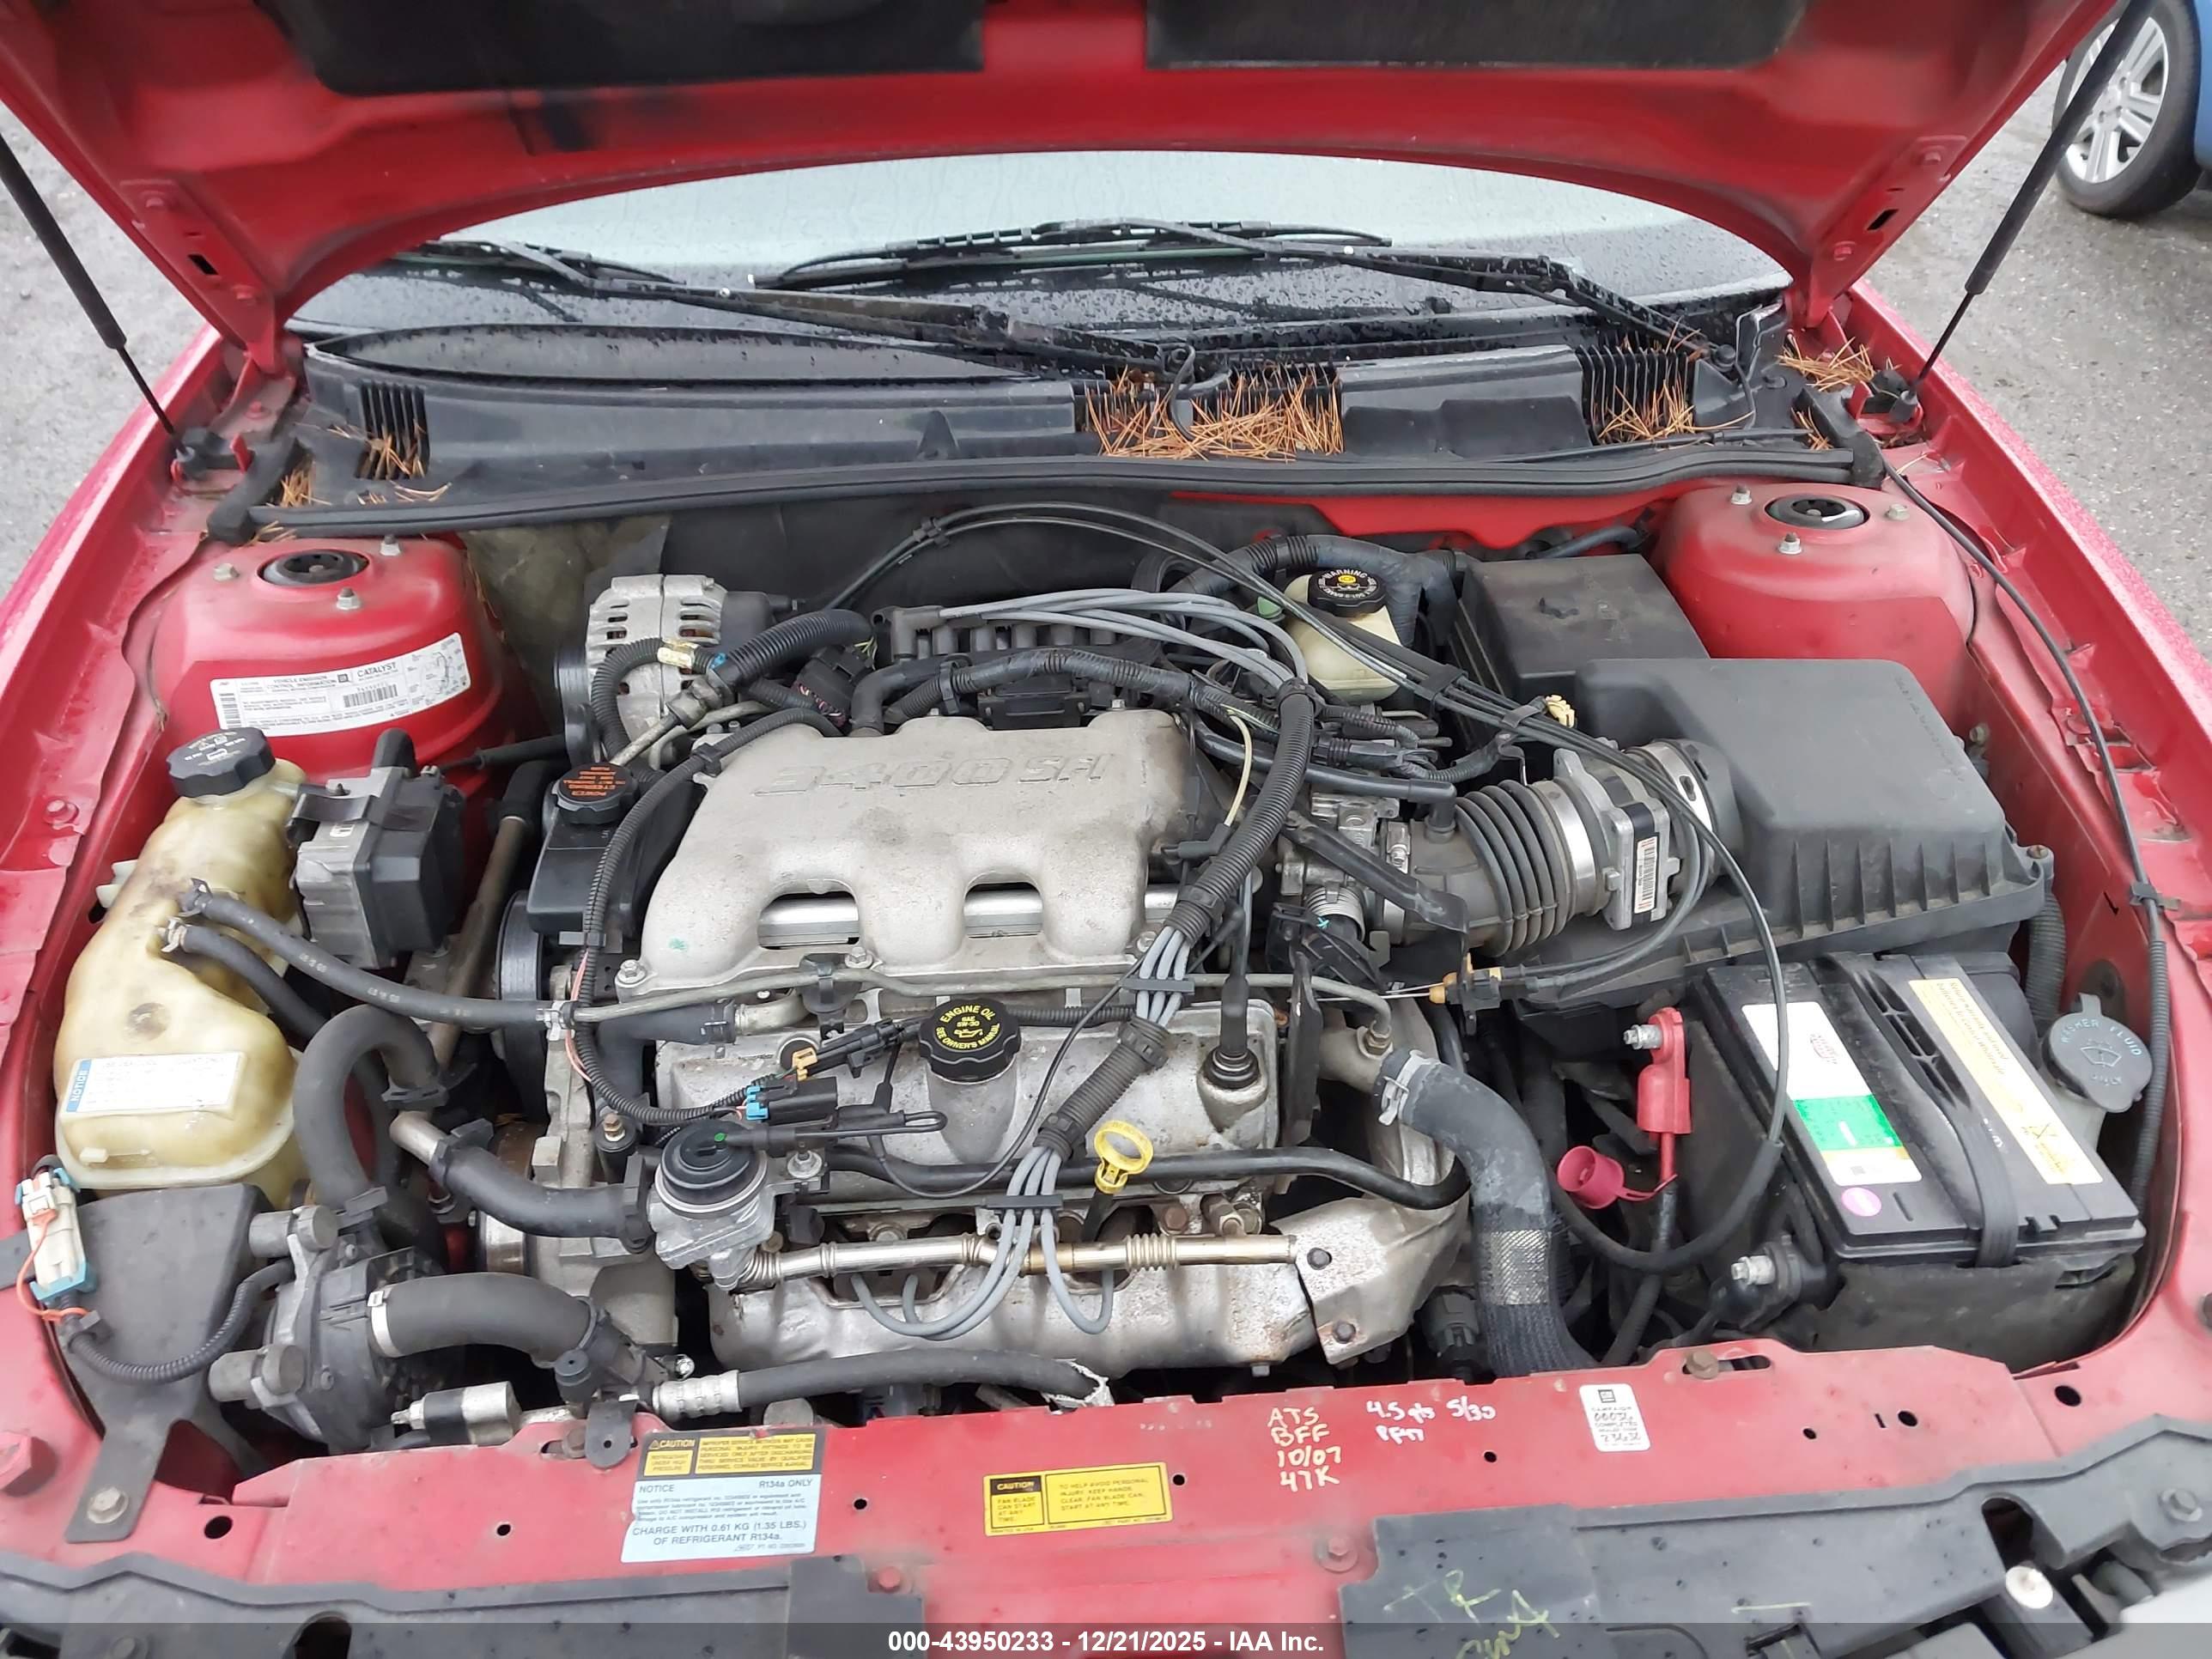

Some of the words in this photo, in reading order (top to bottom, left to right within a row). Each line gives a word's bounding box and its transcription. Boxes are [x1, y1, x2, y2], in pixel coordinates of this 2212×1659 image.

[1322, 568, 1368, 579] WARNING
[356, 662, 397, 678] CATALYST
[753, 757, 1012, 797] 3400
[940, 1006, 981, 1023] ENGINE
[981, 1008, 996, 1020] OIL
[977, 1023, 1000, 1046] MANUAL
[2110, 1026, 2142, 1055] FLUID
[1267, 1407, 1320, 1429] ATS
[659, 1439, 696, 1448] CAUTION
[1271, 1423, 1330, 1447] BFF
[1277, 1445, 1342, 1468] 10/07
[639, 1485, 674, 1493] NOTICE
[759, 1480, 785, 1489] R134a
[788, 1479, 813, 1487] ONLY
[996, 1481, 1035, 1491] CAUTION
[1279, 1465, 1340, 1492] 47K
[632, 1526, 677, 1536] CHARGE
[682, 1524, 708, 1534] WITH
[711, 1523, 731, 1532] 0.61
[734, 1522, 750, 1531] KG
[753, 1522, 776, 1531] (1.35
[780, 1520, 807, 1529] LBS.)
[653, 1536, 669, 1546] OF
[672, 1533, 746, 1545] REFRIGERANT
[750, 1532, 782, 1541] R134a.
